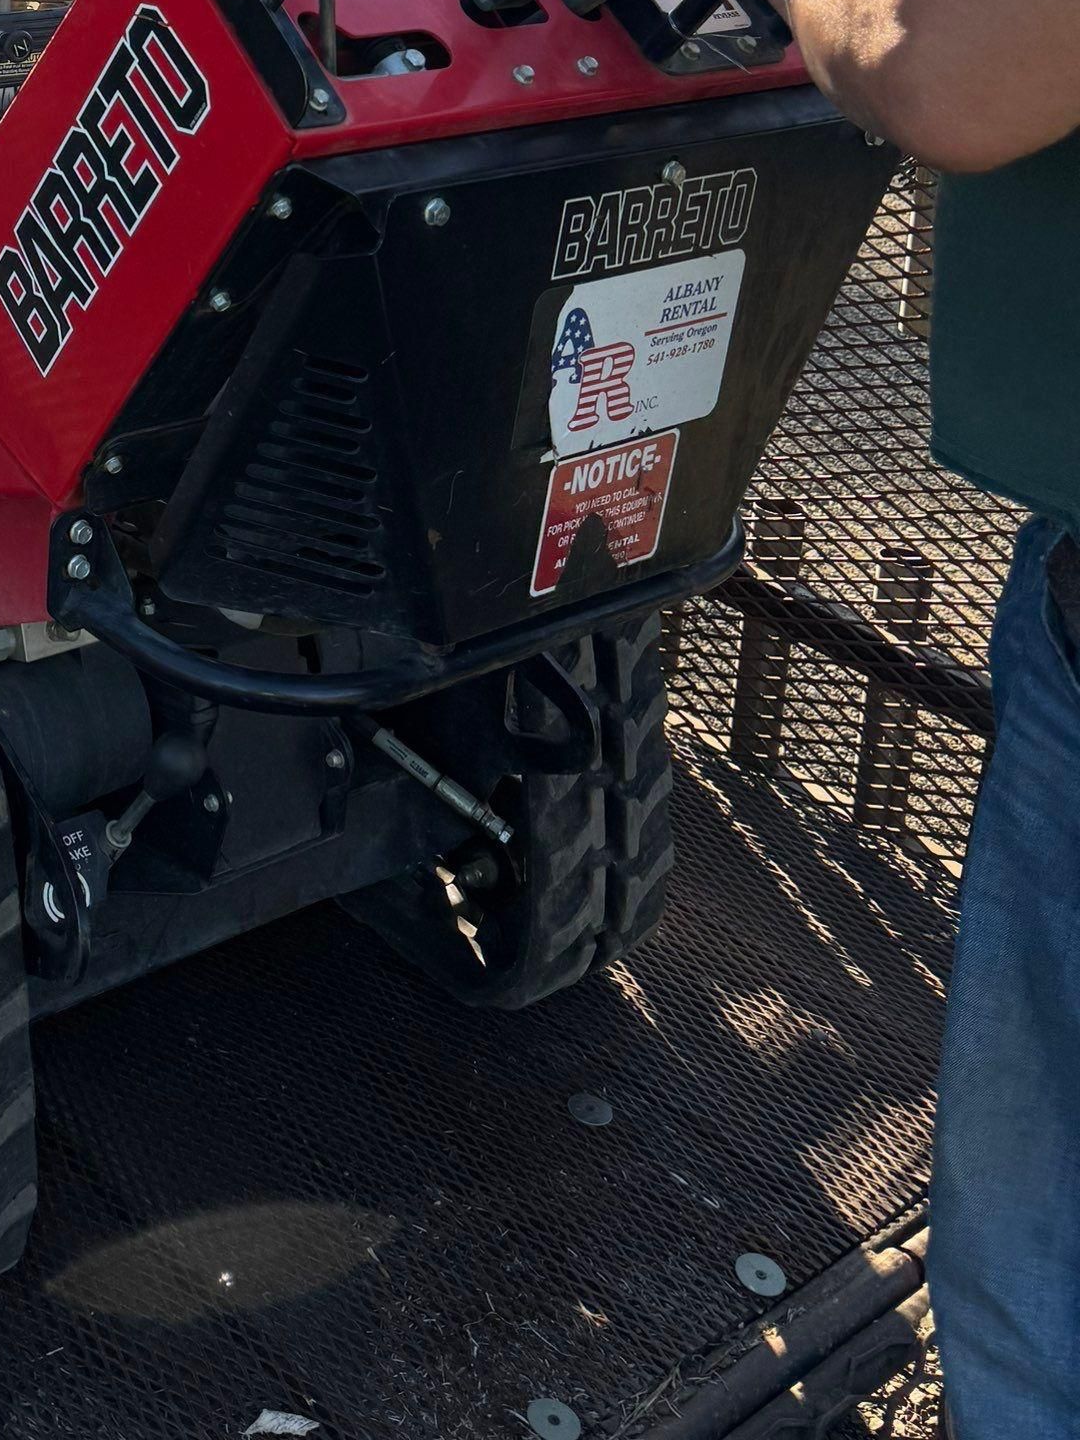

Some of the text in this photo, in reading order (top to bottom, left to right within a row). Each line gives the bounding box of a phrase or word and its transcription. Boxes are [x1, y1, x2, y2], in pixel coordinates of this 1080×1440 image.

[551, 166, 758, 281] BARRETO
[663, 275, 724, 303] ALBANY
[659, 296, 717, 324] RENTAL
[650, 323, 718, 348] Serving Oregon
[646, 338, 715, 366] 541-928-1780
[634, 395, 659, 414] INC.
[575, 500, 591, 514] YOU
[591, 494, 611, 510] NEED
[612, 491, 623, 502] TO
[547, 523, 564, 538] FOR
[604, 504, 621, 518] THIS
[557, 535, 571, 548] OR
[607, 533, 641, 551] ENTAL
[62, 830, 84, 847] OFF
